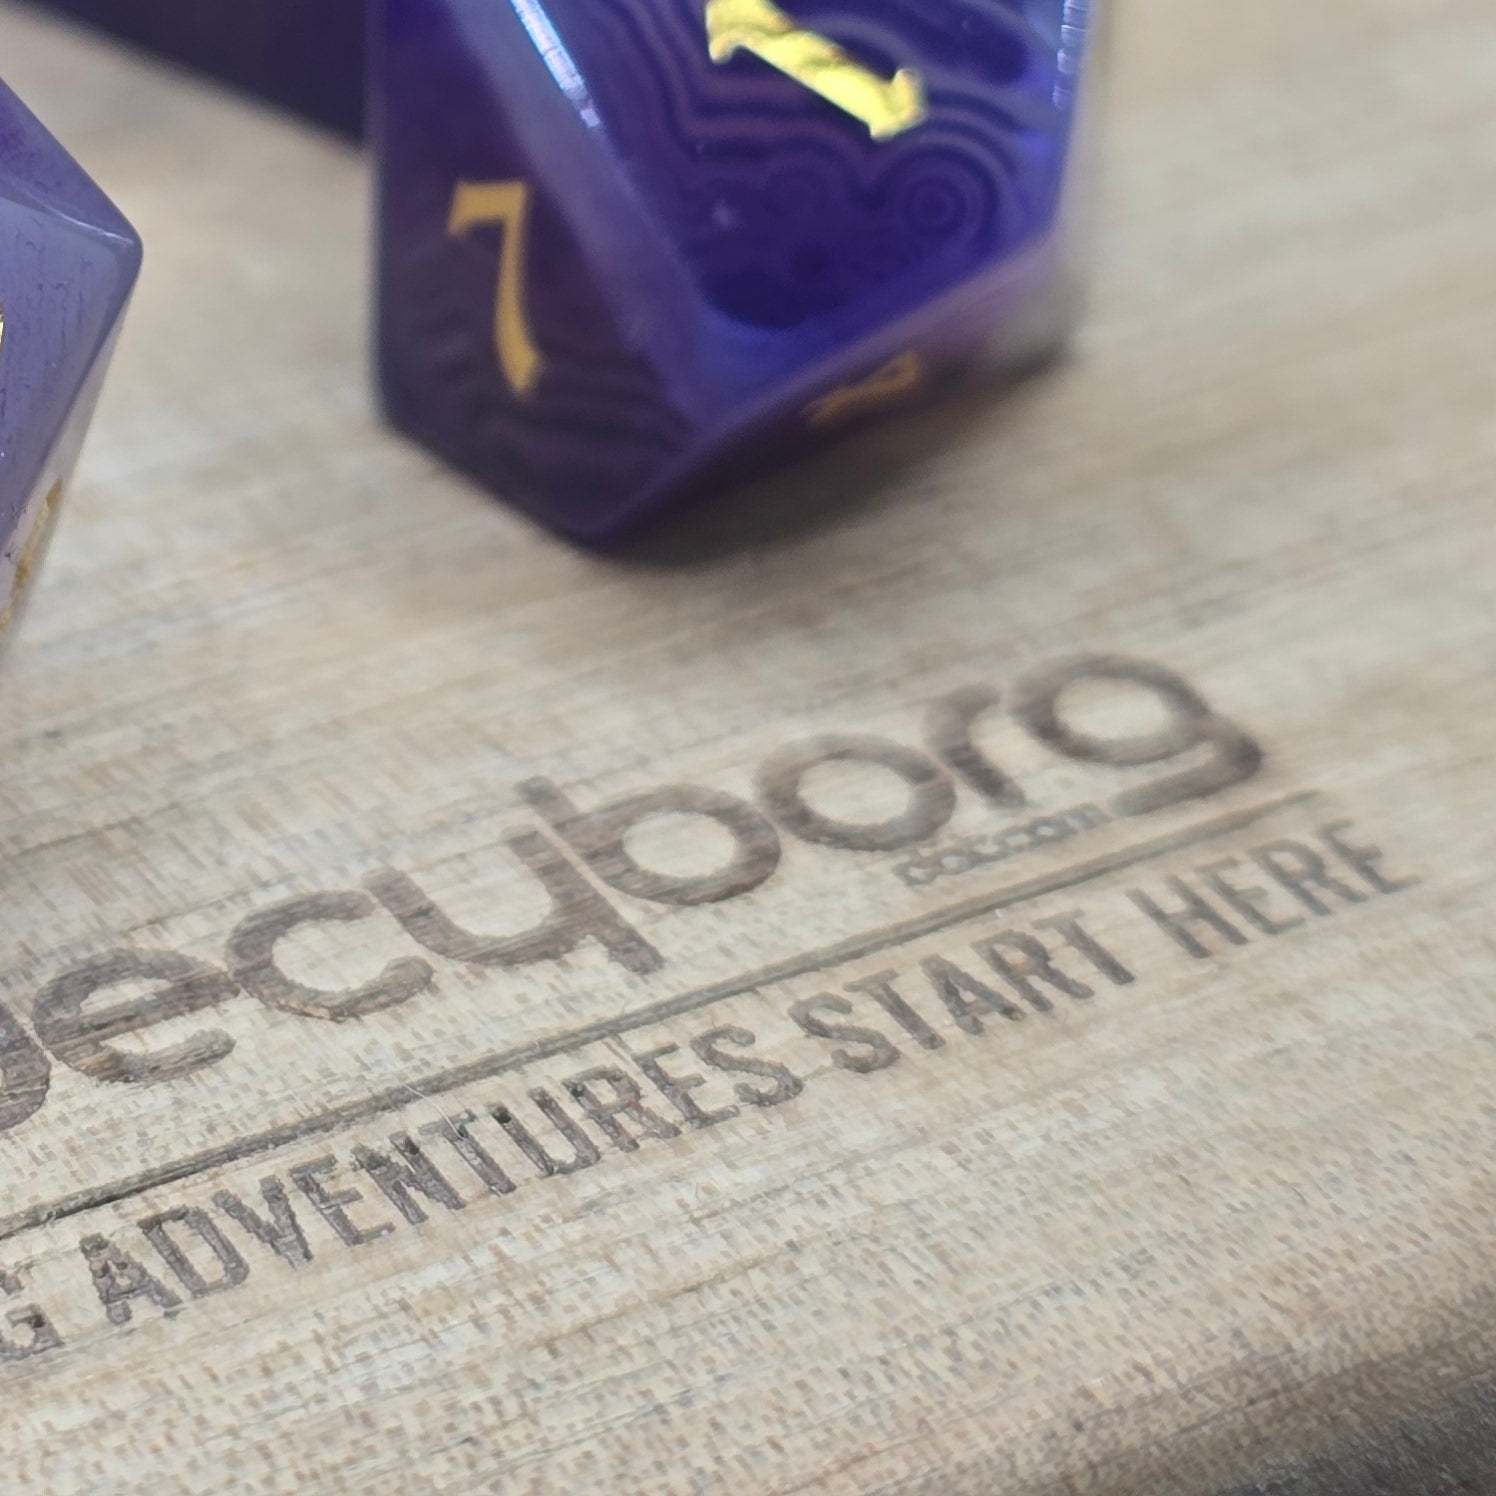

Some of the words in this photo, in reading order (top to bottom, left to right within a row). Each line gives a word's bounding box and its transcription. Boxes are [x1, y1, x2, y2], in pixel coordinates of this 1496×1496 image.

[448, 178, 546, 396] 7
[79, 1022, 804, 1326] ADVENTURES
[788, 909, 1136, 1074] START
[1126, 818, 1422, 962] HERE
